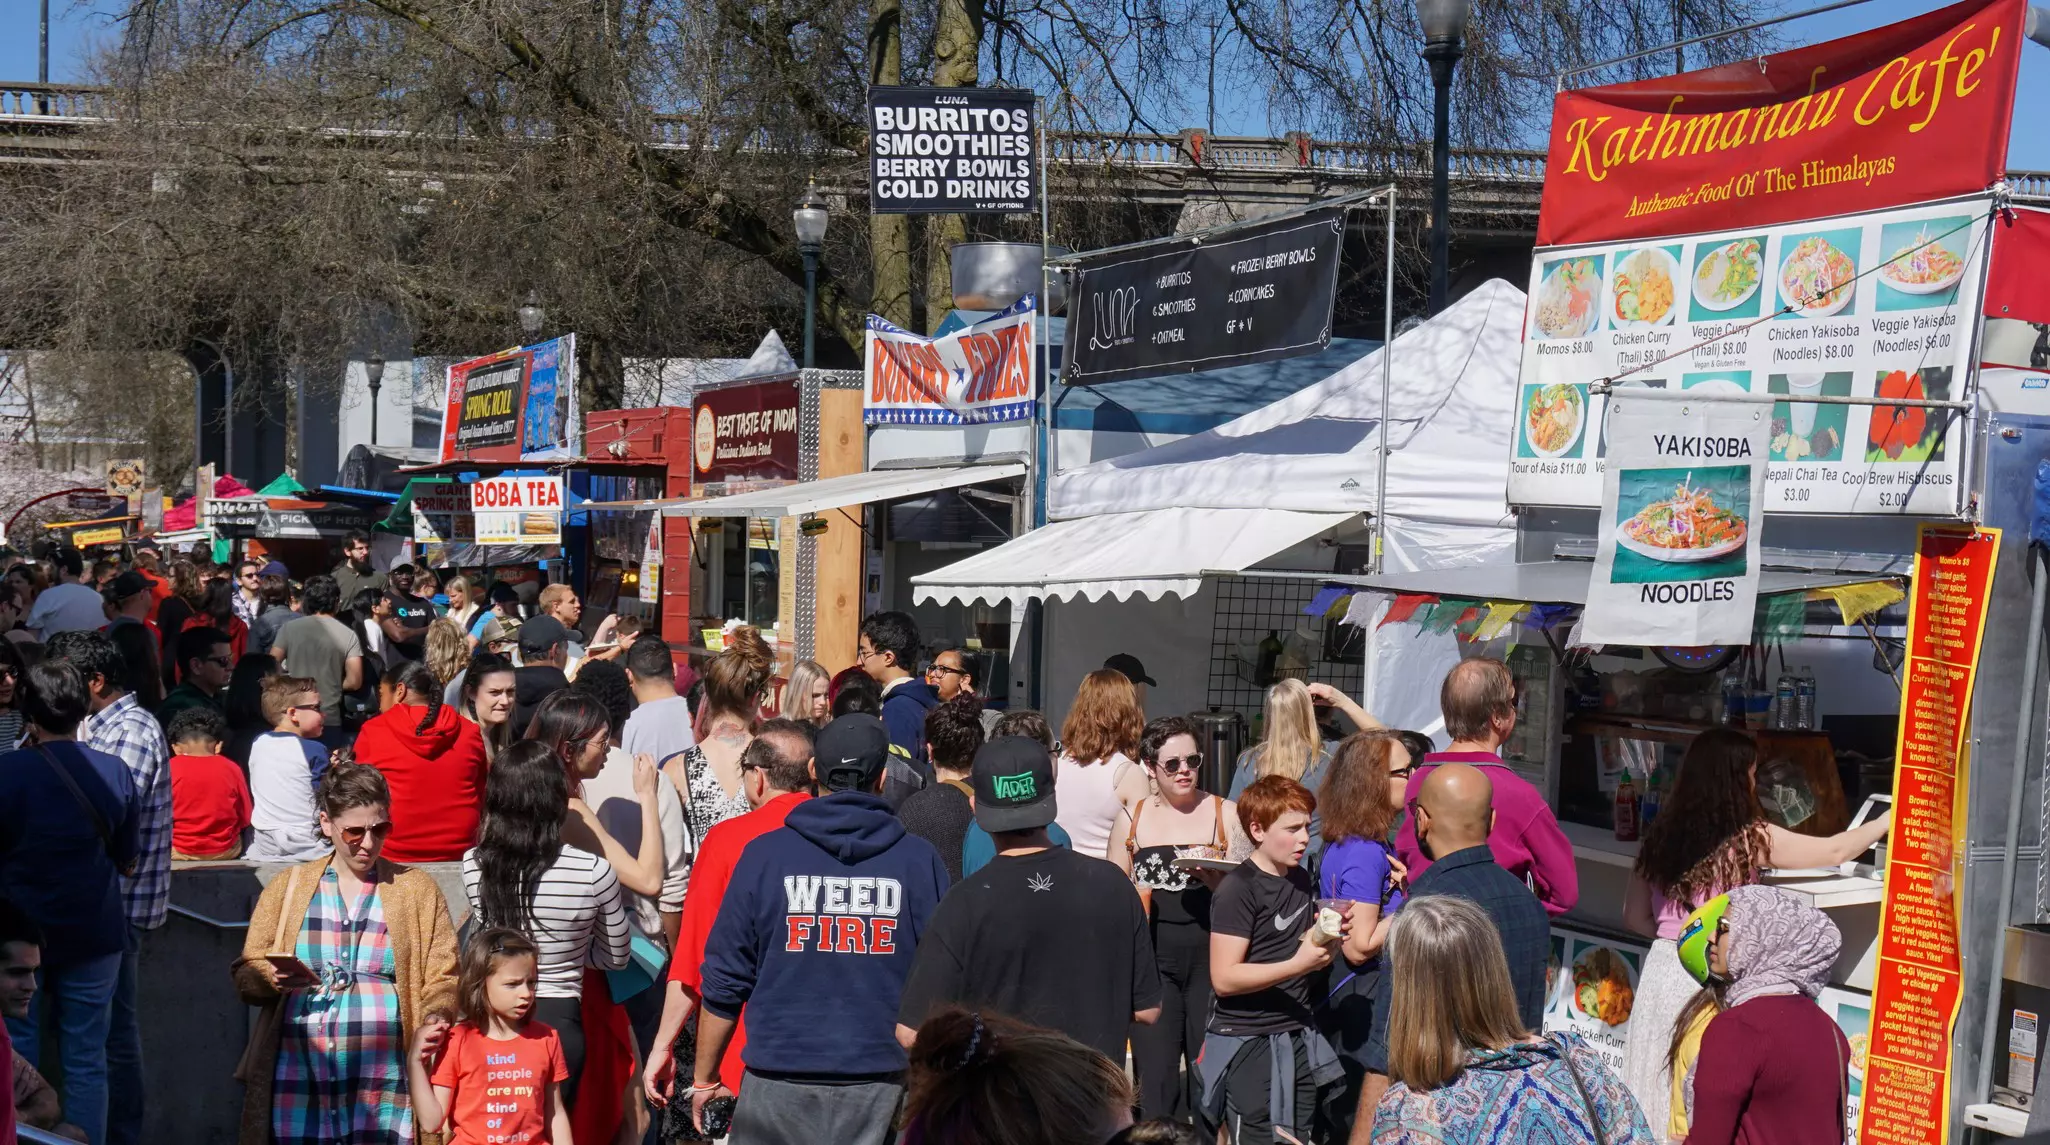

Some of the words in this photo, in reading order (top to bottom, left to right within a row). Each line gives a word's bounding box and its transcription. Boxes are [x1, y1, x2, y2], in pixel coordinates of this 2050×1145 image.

[935, 95, 969, 105] LUNA
[874, 106, 1029, 133] BURRITOS
[1563, 65, 1845, 182] Kathmandu
[875, 133, 1030, 156] SMOOTHIES
[876, 158, 950, 177] BERRY
[957, 159, 1030, 178] BOWLS
[877, 179, 939, 199] COLD
[946, 179, 1030, 199] DRINKS
[1624, 190, 1695, 219] Authentic
[1691, 176, 1734, 206] Food
[1736, 170, 1760, 198] Of
[1763, 165, 1797, 192] The
[1801, 152, 1896, 188] Himalayas
[1236, 257, 1265, 275] FROZEN
[1265, 252, 1288, 270] BERRY
[1289, 246, 1316, 265] BOWLS
[1160, 271, 1192, 289] BURRITOS
[1234, 284, 1275, 304] CORNCAKES
[1158, 298, 1196, 316] SMOOTHIES
[1226, 320, 1236, 334] GF
[1247, 317, 1253, 331] V
[1871, 317, 1910, 334] Veggie
[1912, 313, 1956, 329] Yakisoba
[1157, 328, 1185, 344] OATMEAL
[1612, 332, 1645, 346] Chicken
[1647, 331, 1671, 346] Curry
[1691, 325, 1723, 341] Veggie
[1724, 323, 1751, 338] Curry
[1768, 326, 1808, 341] Chicken
[1811, 324, 1860, 339] Yakisoba
[1536, 342, 1570, 355] Momos
[1572, 340, 1594, 354] $8.00
[1722, 341, 1747, 357] $8.00
[1872, 337, 1923, 356] (Noodles)
[1925, 333, 1951, 351] $6.00
[1616, 350, 1642, 366] (Thali)
[1643, 349, 1666, 363] $8.00
[1772, 346, 1822, 364] (Noodles)
[1825, 344, 1854, 359] $8.00
[957, 321, 1031, 404] FRIES
[1694, 361, 1710, 370] Vegan
[1716, 360, 1733, 368] Gluten
[1733, 359, 1746, 367] Free
[465, 392, 492, 420] SPRING
[491, 389, 512, 416] ROLL
[503, 420, 516, 433] 1977
[716, 414, 738, 439] BEST
[736, 412, 760, 438] TASTE
[760, 410, 773, 433] OF
[773, 407, 797, 434] INDIA
[716, 443, 739, 460] Delicious
[739, 440, 757, 458] Indian
[758, 438, 772, 456] Food
[1653, 434, 1752, 458] YAKISOBA
[1511, 461, 1528, 473] Tour
[1531, 461, 1539, 474] of
[1540, 462, 1558, 474] Asia
[1560, 462, 1587, 475] $11.00
[1795, 467, 1818, 481] Chai
[1822, 467, 1837, 481] Tea
[1842, 471, 1866, 485] Cool
[1868, 472, 1895, 485] Brew
[1897, 471, 1953, 485] Hisbiscus
[435, 484, 469, 495] GIANT
[474, 481, 522, 507] BOBA
[527, 481, 560, 506] TEA
[1784, 487, 1810, 501] $3.00
[415, 497, 454, 511] SPRING
[1879, 492, 1907, 507] $2.00
[236, 517, 256, 525] OR
[280, 514, 310, 523] PICK
[314, 515, 331, 524] UP
[336, 516, 368, 525] HERE
[1640, 580, 1735, 604] NOODLES
[1912, 674, 1930, 685] Curry
[1905, 740, 1917, 750] You
[1909, 752, 1927, 763] know
[1913, 771, 1927, 781] Tour
[992, 771, 1036, 799] VADER
[1908, 794, 1929, 806] Brown
[1911, 808, 1931, 818] spiced
[1902, 817, 1922, 828] salad,
[1905, 838, 1919, 848] Two
[1909, 882, 1915, 891] A
[784, 875, 902, 917] WEED
[1896, 893, 1923, 904] covered
[1893, 903, 1915, 913] yogurt
[1915, 907, 1935, 918] sauce,
[1895, 913, 1910, 925] high
[785, 915, 898, 955] FIRE
[1891, 924, 1915, 934] curried
[1915, 929, 1939, 940] veggies,
[1906, 938, 1917, 947] red
[1905, 949, 1925, 959] sauce.
[1926, 951, 1944, 964] Yikes!
[1897, 964, 1916, 977] Go-Gi
[1916, 967, 1946, 983] Vegetarian
[1901, 978, 1908, 986] or
[1909, 979, 1931, 992] chicken
[1890, 1000, 1915, 1013] veggies
[1885, 1010, 1907, 1021] served
[1907, 1014, 1913, 1023] in
[1880, 1021, 1902, 1032] pocket
[1902, 1025, 1920, 1037] bread,
[1605, 1034, 1626, 1049] Curr
[1883, 1031, 1896, 1041] you
[1896, 1034, 1912, 1045] can't
[486, 1053, 516, 1065] kind
[1601, 1052, 1623, 1069] $8.00
[1887, 1044, 1899, 1054] you
[1900, 1046, 1916, 1057] when
[1915, 1050, 1926, 1060] you
[1926, 1053, 1934, 1063] go
[487, 1068, 533, 1083] people
[486, 1086, 511, 1097] are
[514, 1086, 533, 1098] my
[1874, 1083, 1885, 1093] low
[1885, 1086, 1893, 1096] fat
[1893, 1089, 1913, 1102] quickly
[486, 1102, 517, 1114] kind
[486, 1118, 503, 1129] of
[1915, 1129, 1926, 1140] soy
